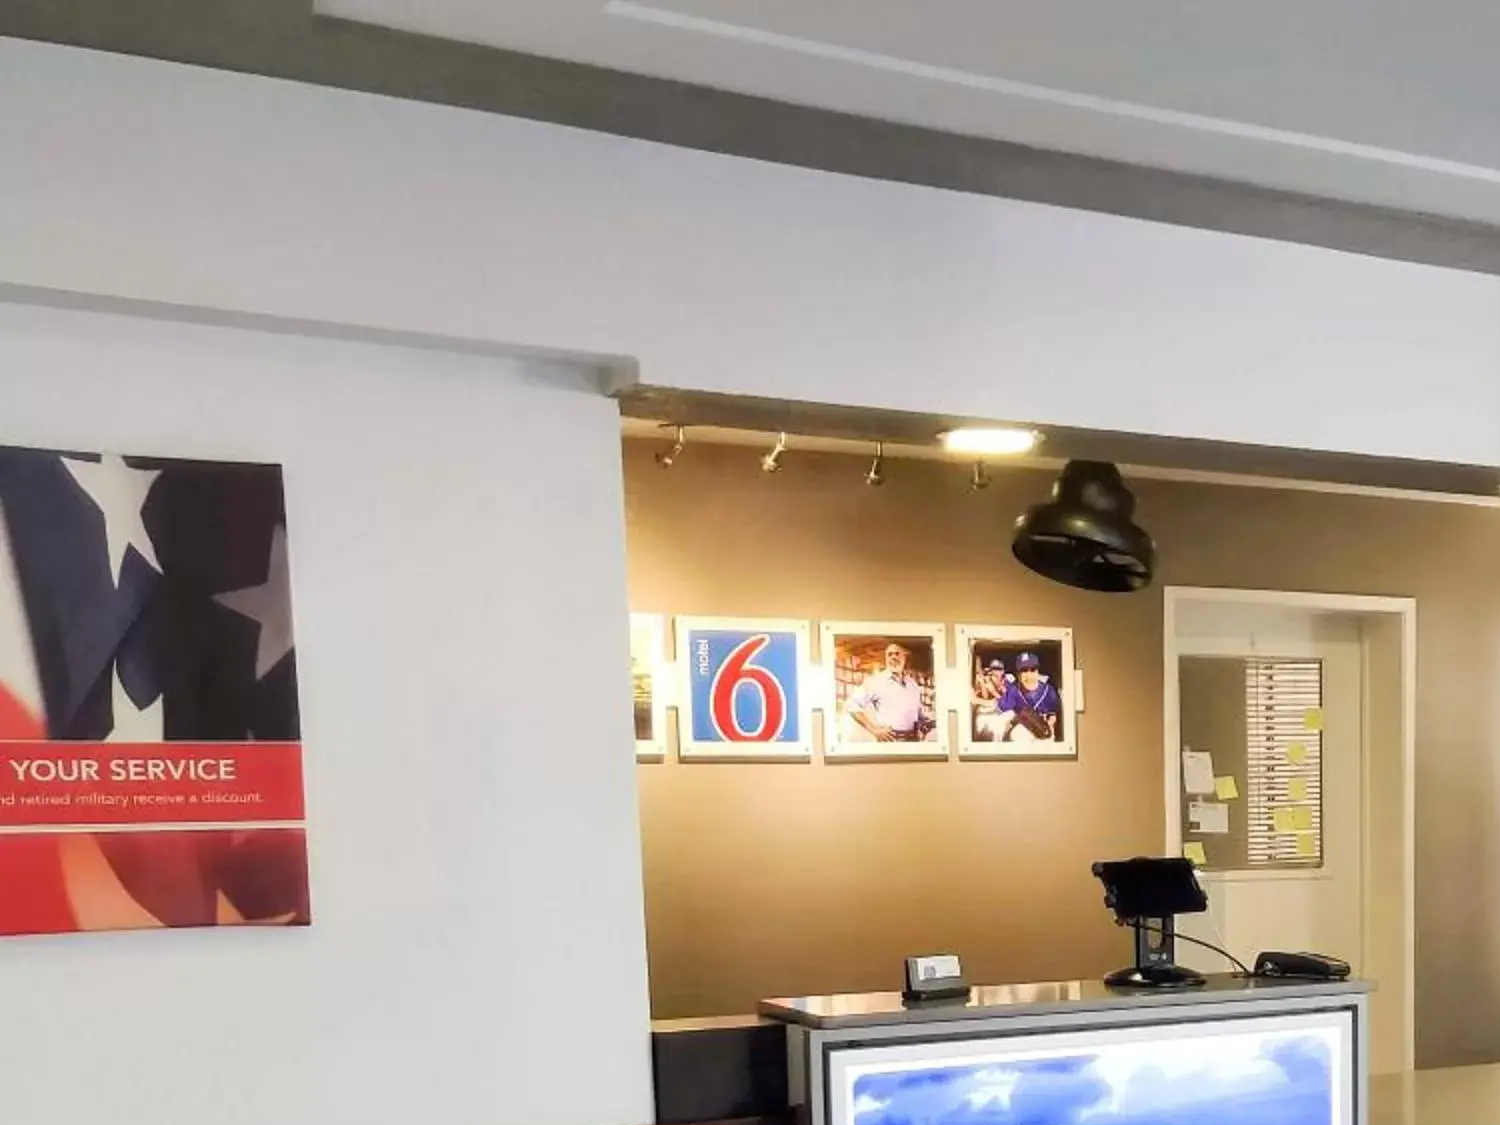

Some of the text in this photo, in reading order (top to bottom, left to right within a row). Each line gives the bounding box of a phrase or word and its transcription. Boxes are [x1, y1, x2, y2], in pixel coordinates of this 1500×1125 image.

[710, 633, 787, 742] 6
[8, 757, 237, 782] YOUR SERVICE
[21, 793, 71, 806] retired
[75, 792, 129, 808] military
[133, 792, 185, 806] receive
